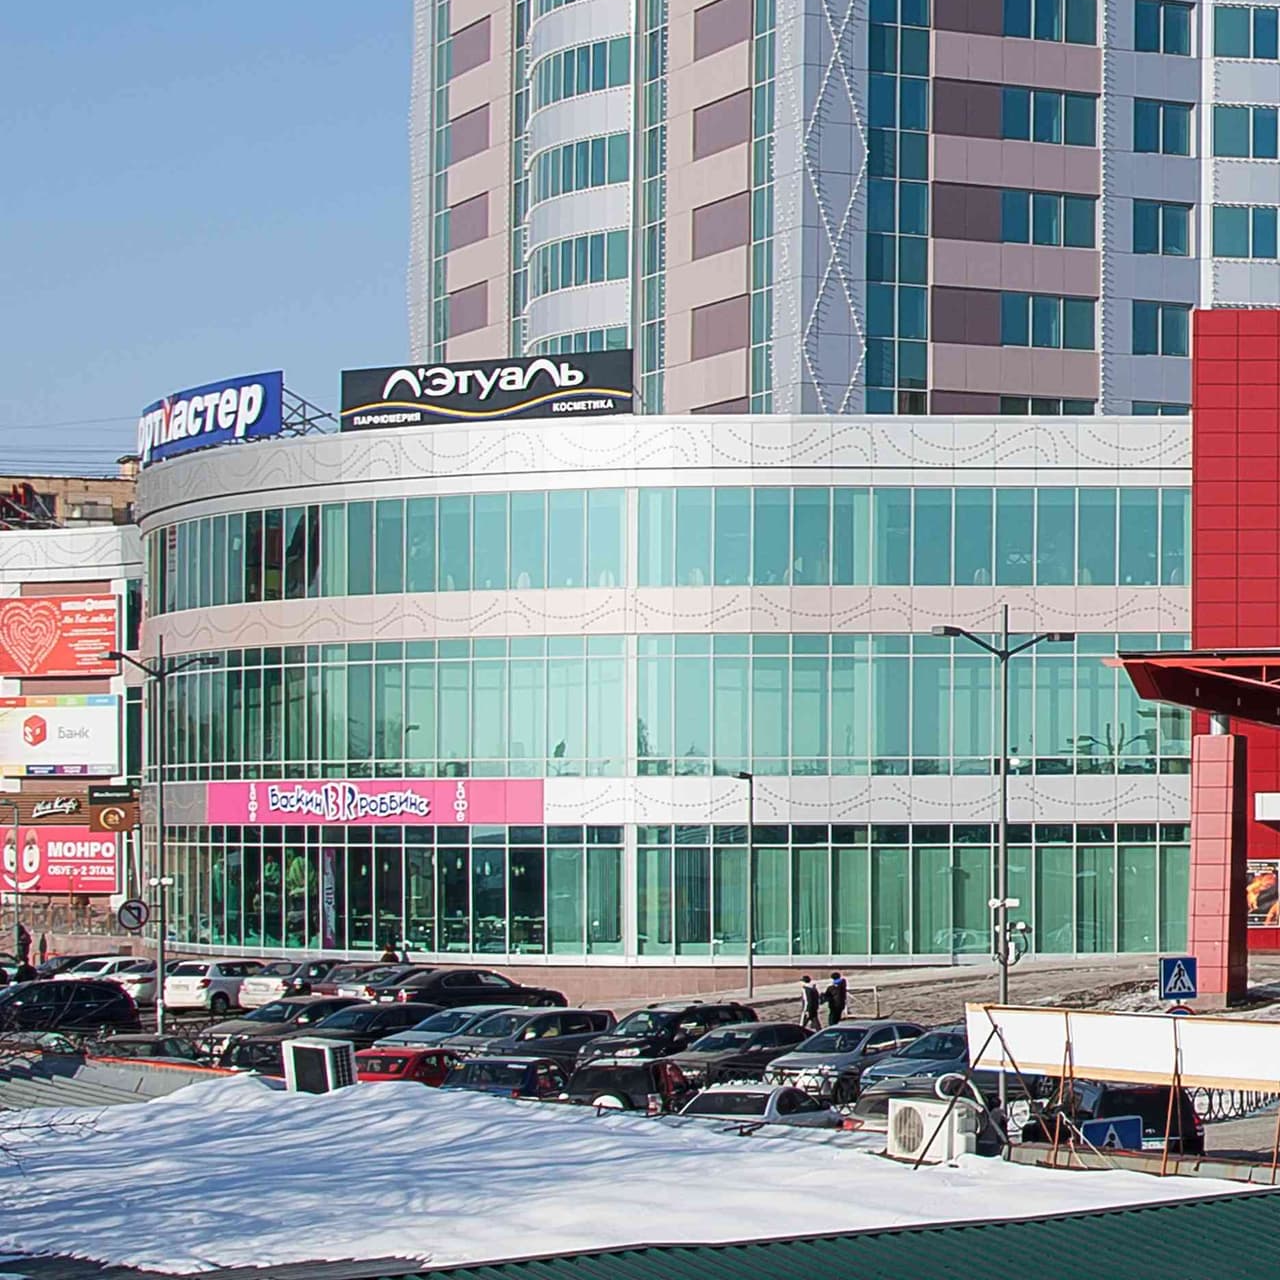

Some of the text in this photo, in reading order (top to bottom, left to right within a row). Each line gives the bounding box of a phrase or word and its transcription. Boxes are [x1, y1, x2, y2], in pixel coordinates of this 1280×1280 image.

[552, 399, 615, 413] КОСМЕТИКА
[353, 412, 422, 427] ПАРФЮМЕРИЯ
[57, 726, 90, 740] Банк
[47, 841, 115, 859] МОНРО
[89, 865, 115, 876] ЭТАЖ
